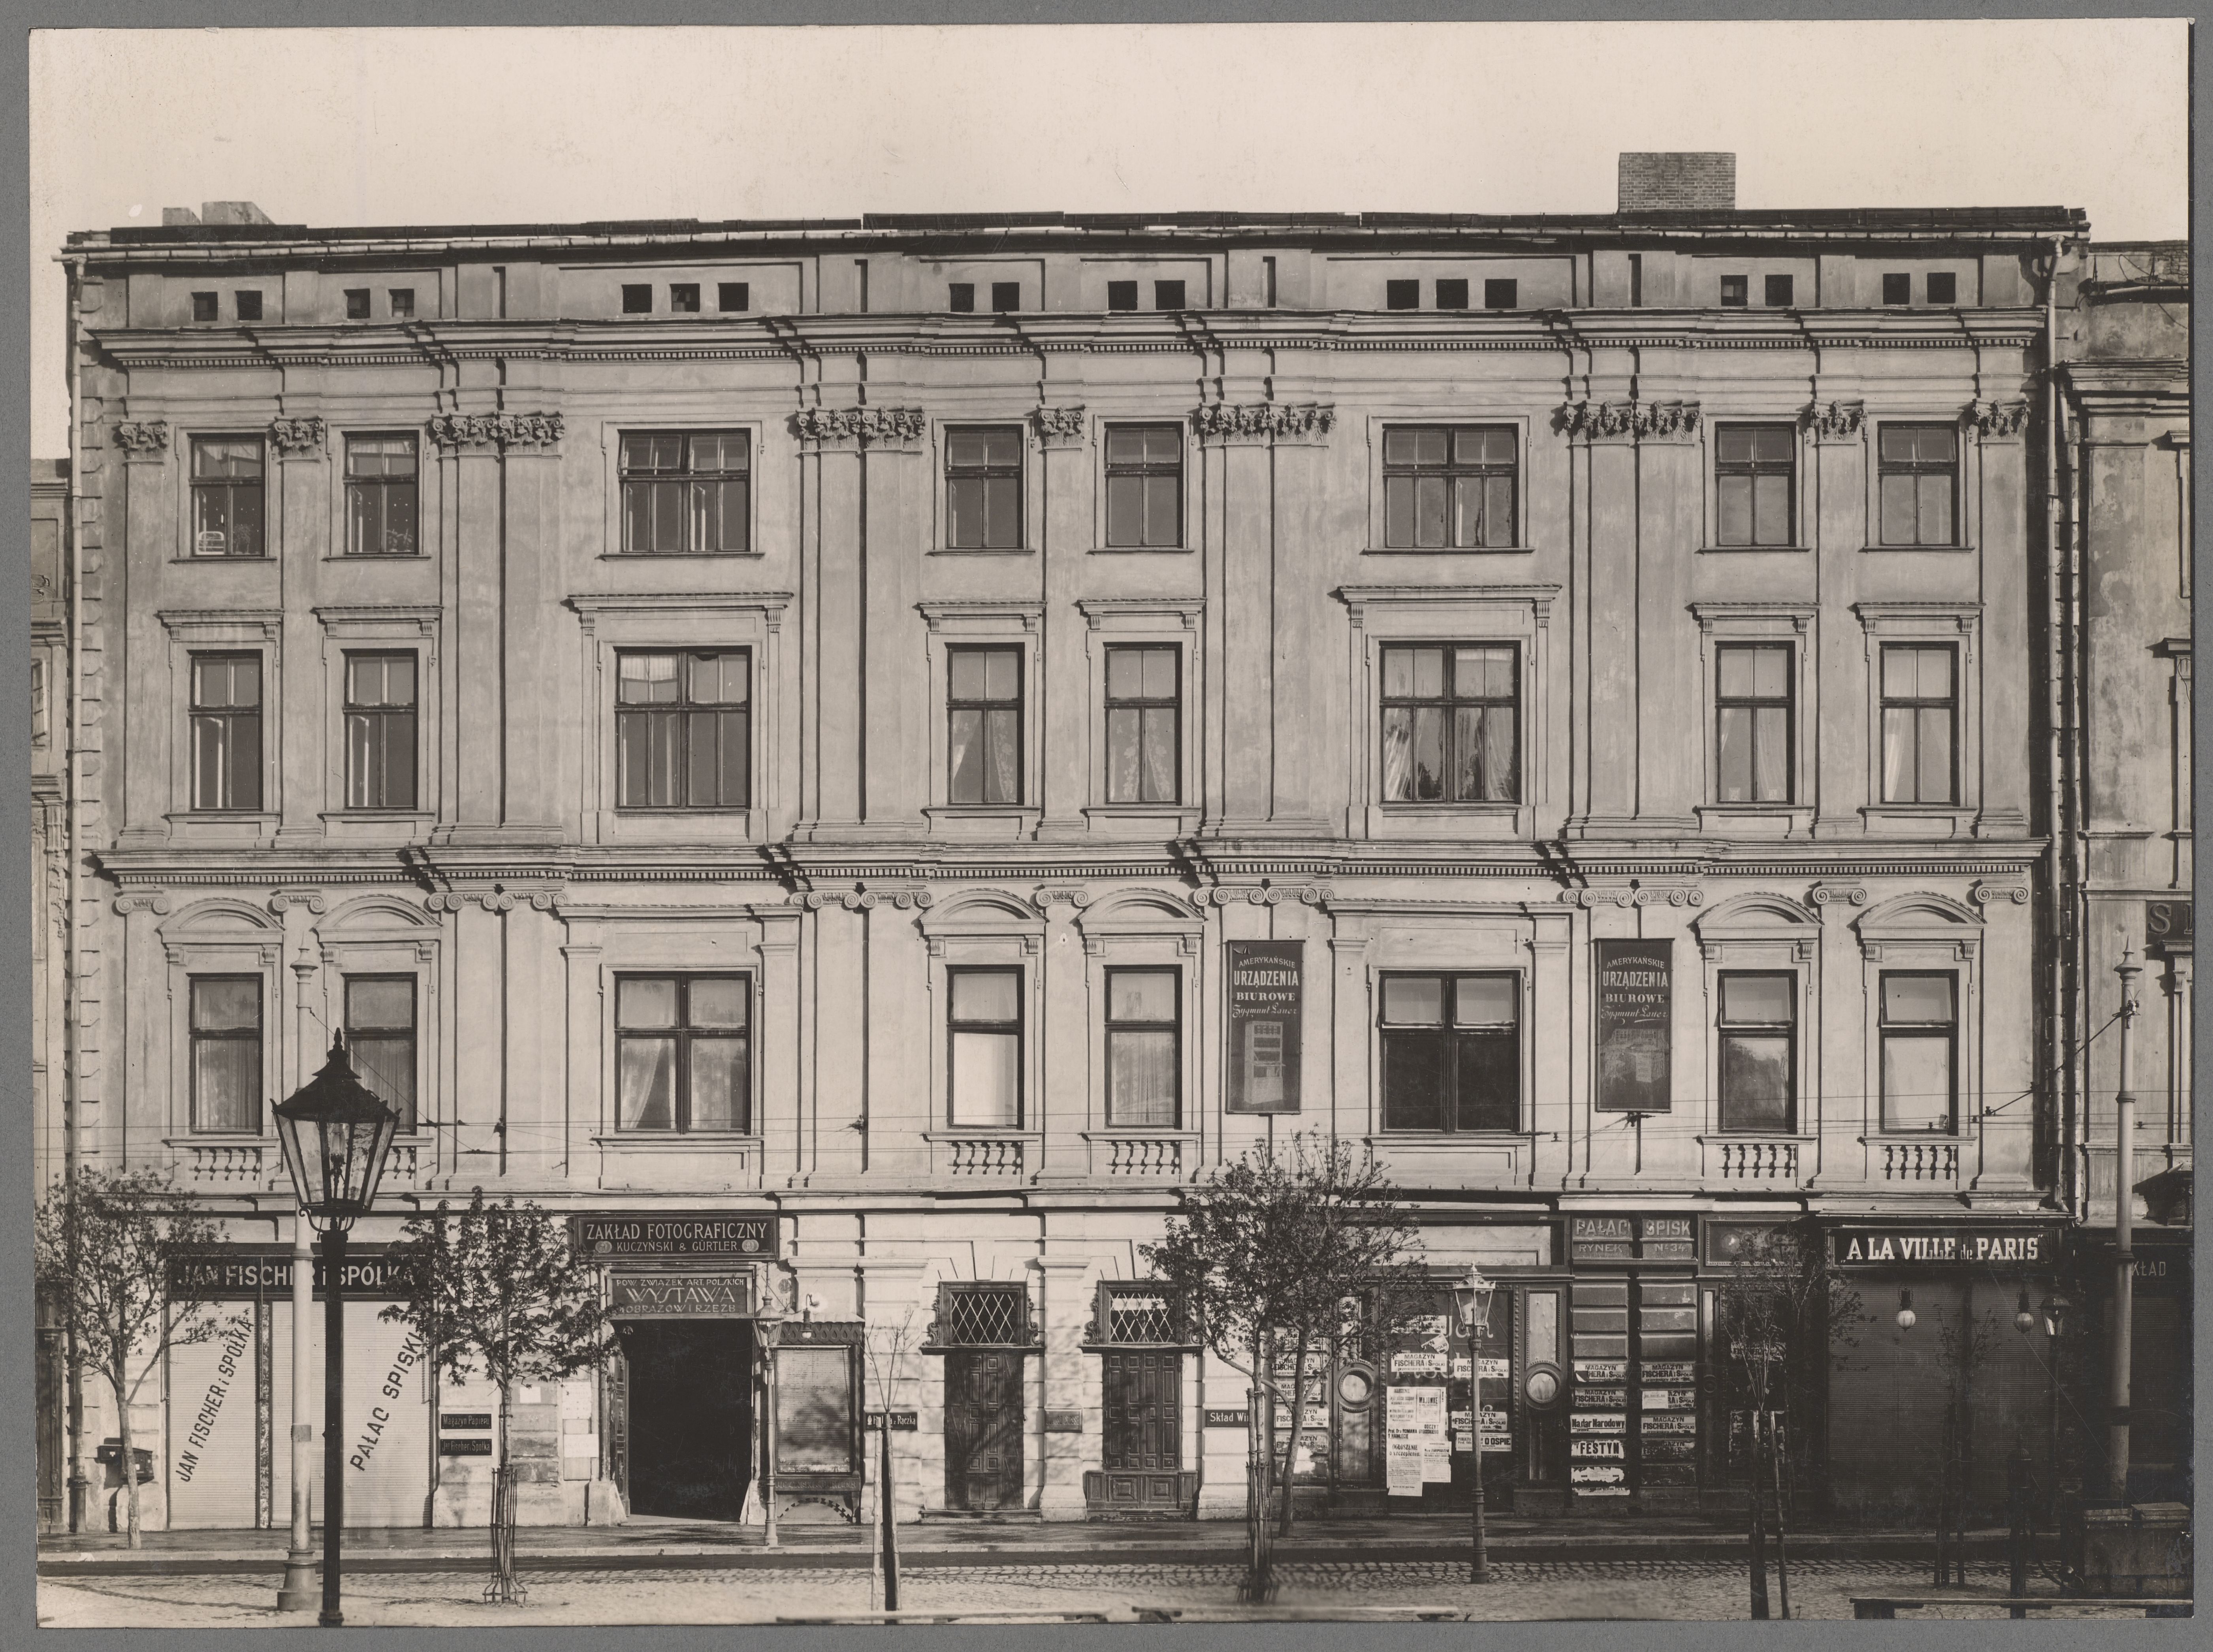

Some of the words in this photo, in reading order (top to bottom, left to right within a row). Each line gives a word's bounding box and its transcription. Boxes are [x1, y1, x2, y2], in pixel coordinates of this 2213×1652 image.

[1238, 956, 1295, 968] AMERYKAŃSKIE
[1607, 956, 1664, 969] AMERYKAŃSKIE
[1234, 970, 1299, 988] URZĄDZENIA
[1603, 971, 1668, 990] URZĄDZENIA
[587, 1224, 640, 1239] ZAKŁAD
[648, 1223, 767, 1239] FOTOGRAFICZNY
[1577, 1220, 1628, 1235] PAŁAC
[617, 1240, 673, 1252] KUCZYŃSKI
[679, 1243, 687, 1251] &
[693, 1240, 740, 1251] GÜRTLER.
[1579, 1244, 1622, 1252] RYNEK
[1868, 1238, 1895, 1260] LA
[1900, 1238, 1956, 1260] VILLE
[1961, 1244, 1973, 1260] de
[226, 1265, 316, 1286] FISCH
[2132, 1261, 2166, 1276] KŁAD
[626, 1287, 735, 1303] WYSTAWA
[442, 1415, 467, 1426] Magazyn
[469, 1415, 489, 1426] Papieru
[1210, 1412, 1233, 1422] Skład
[1593, 1419, 1625, 1429] Narodowy
[175, 1450, 199, 1482] JAN
[188, 1385, 227, 1448] FISCHER
[350, 1407, 389, 1471] PAŁAC
[451, 1441, 469, 1451] Fischer
[1580, 1443, 1619, 1454] FESTYN
